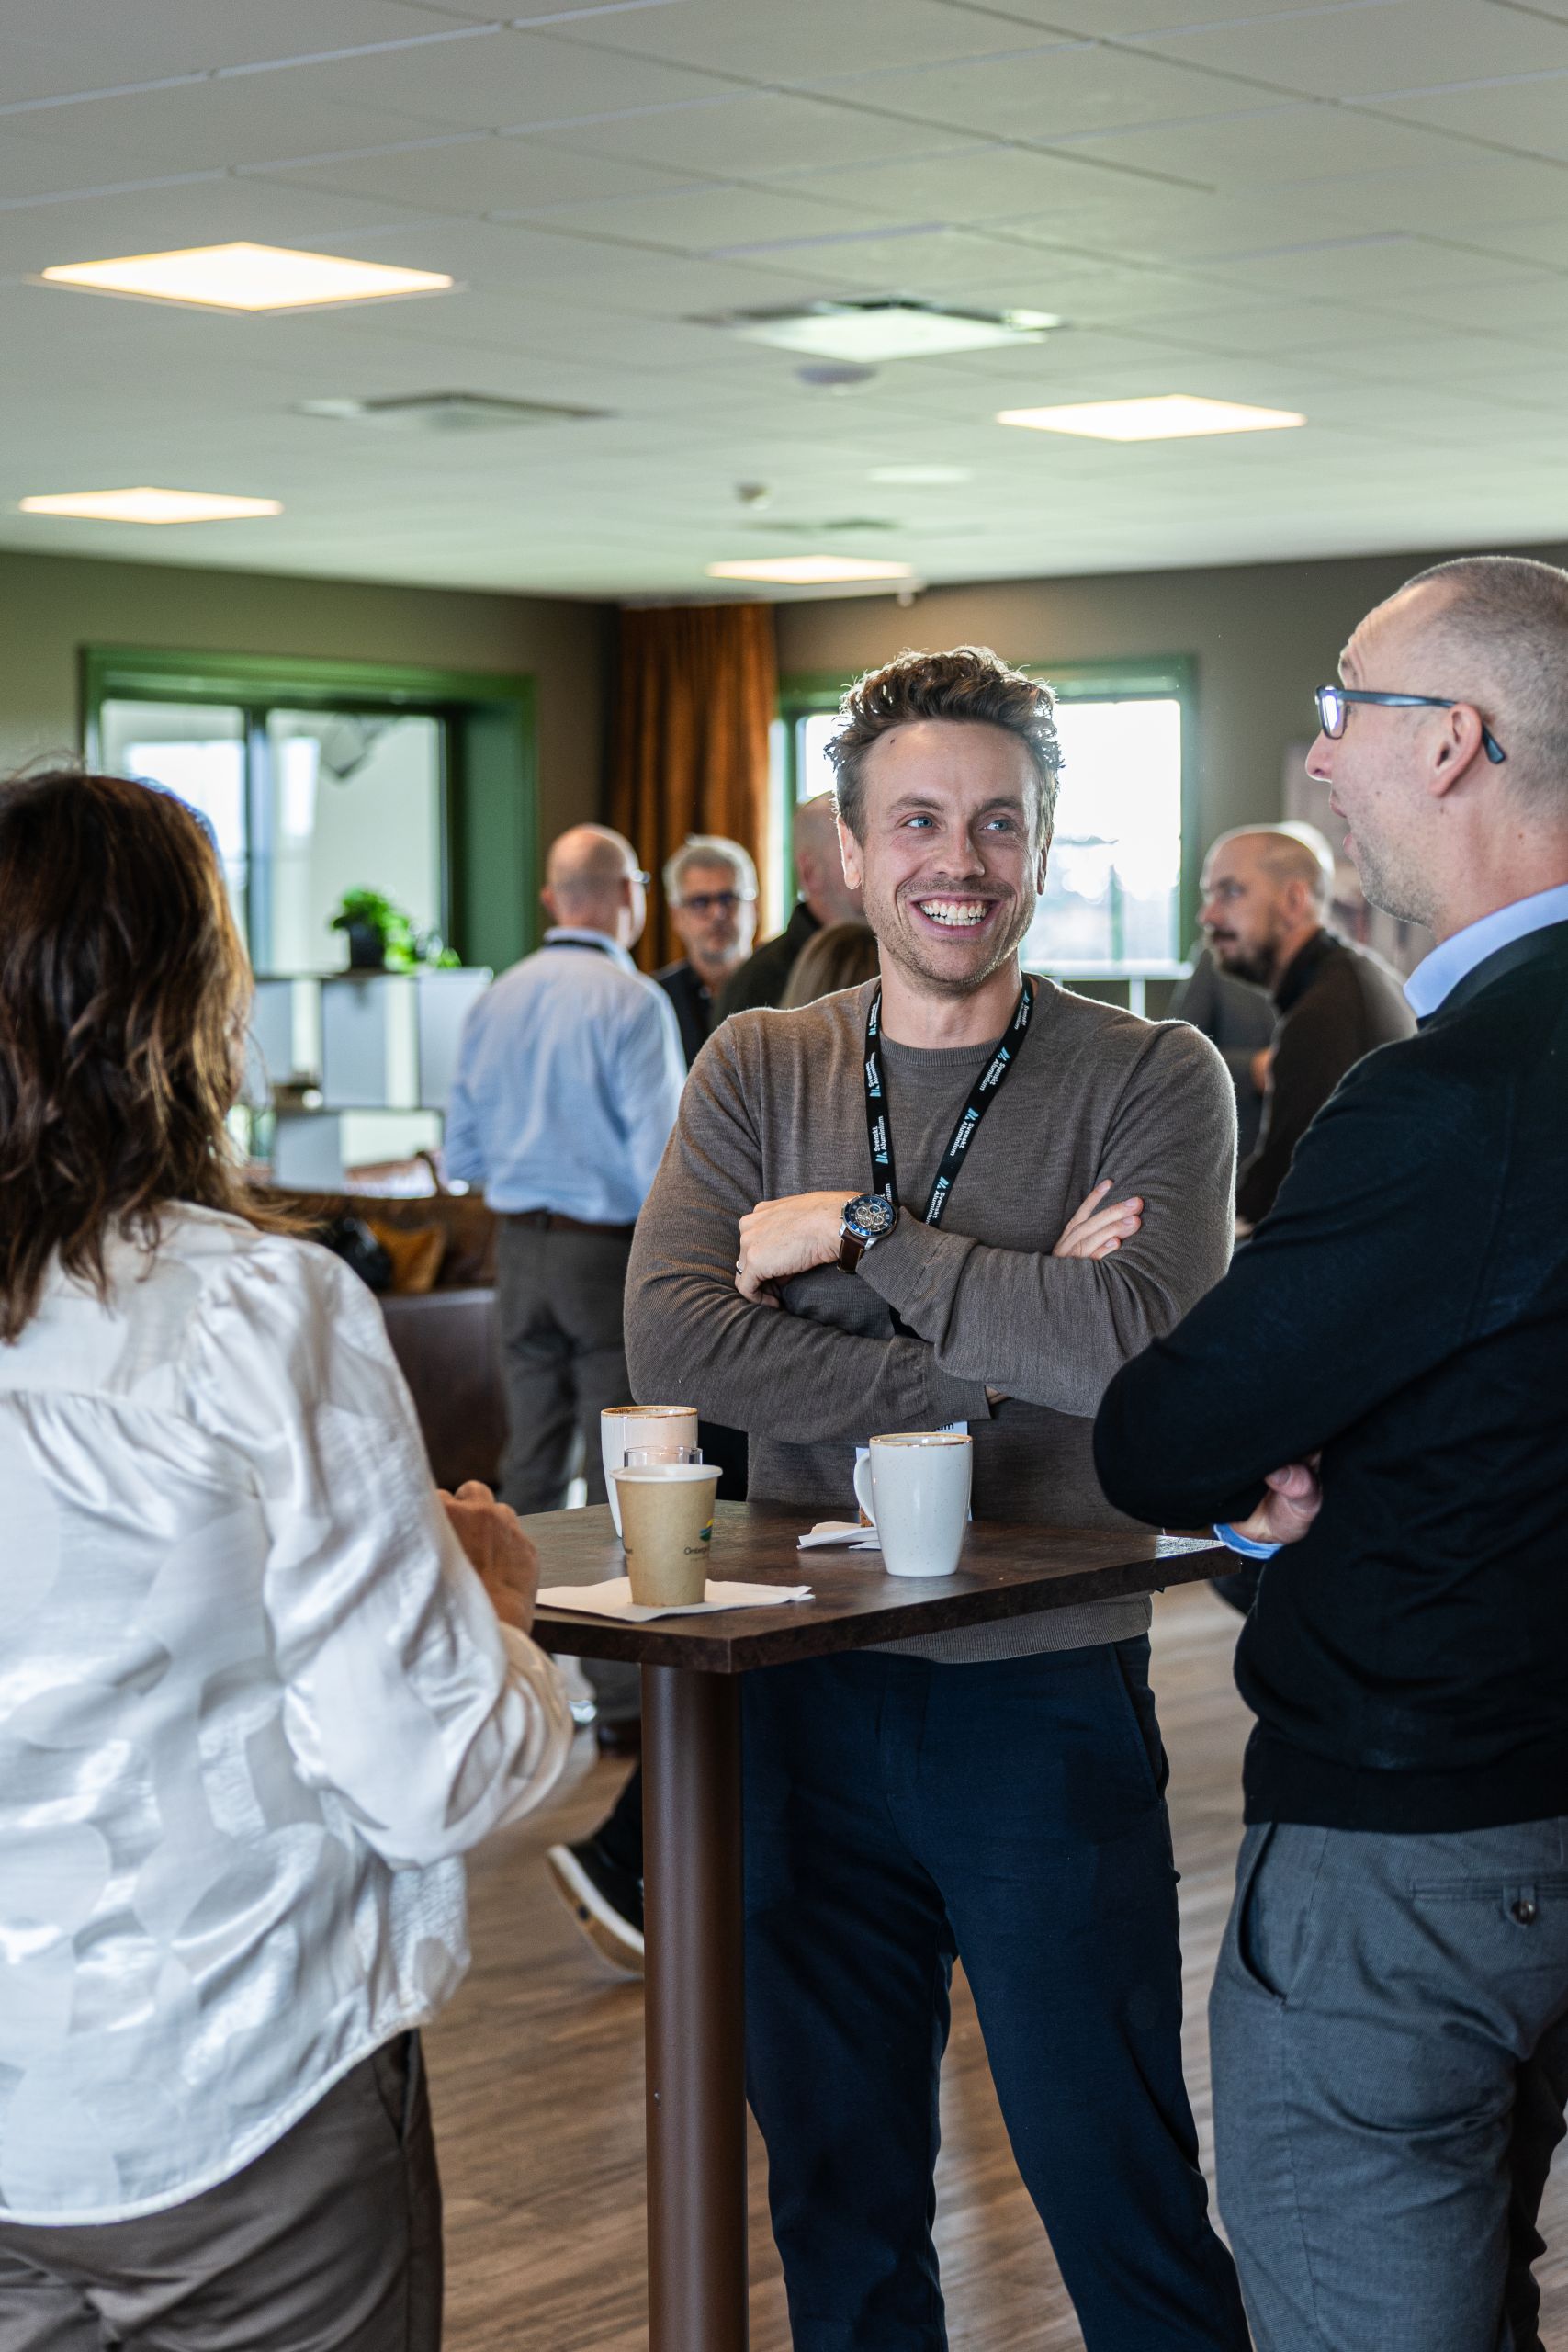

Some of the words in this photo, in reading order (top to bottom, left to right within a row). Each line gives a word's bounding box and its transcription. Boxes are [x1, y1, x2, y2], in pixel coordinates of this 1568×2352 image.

[979, 1058, 999, 1091] Aluminium
[989, 1062, 1006, 1085] Svenskt
[872, 1125, 881, 1152] Svenskt
[878, 1115, 887, 1150] Aluminium
[950, 1120, 968, 1157] Aluminium
[959, 1123, 975, 1148] Svenskt
[932, 1192, 946, 1219] Svenskt
